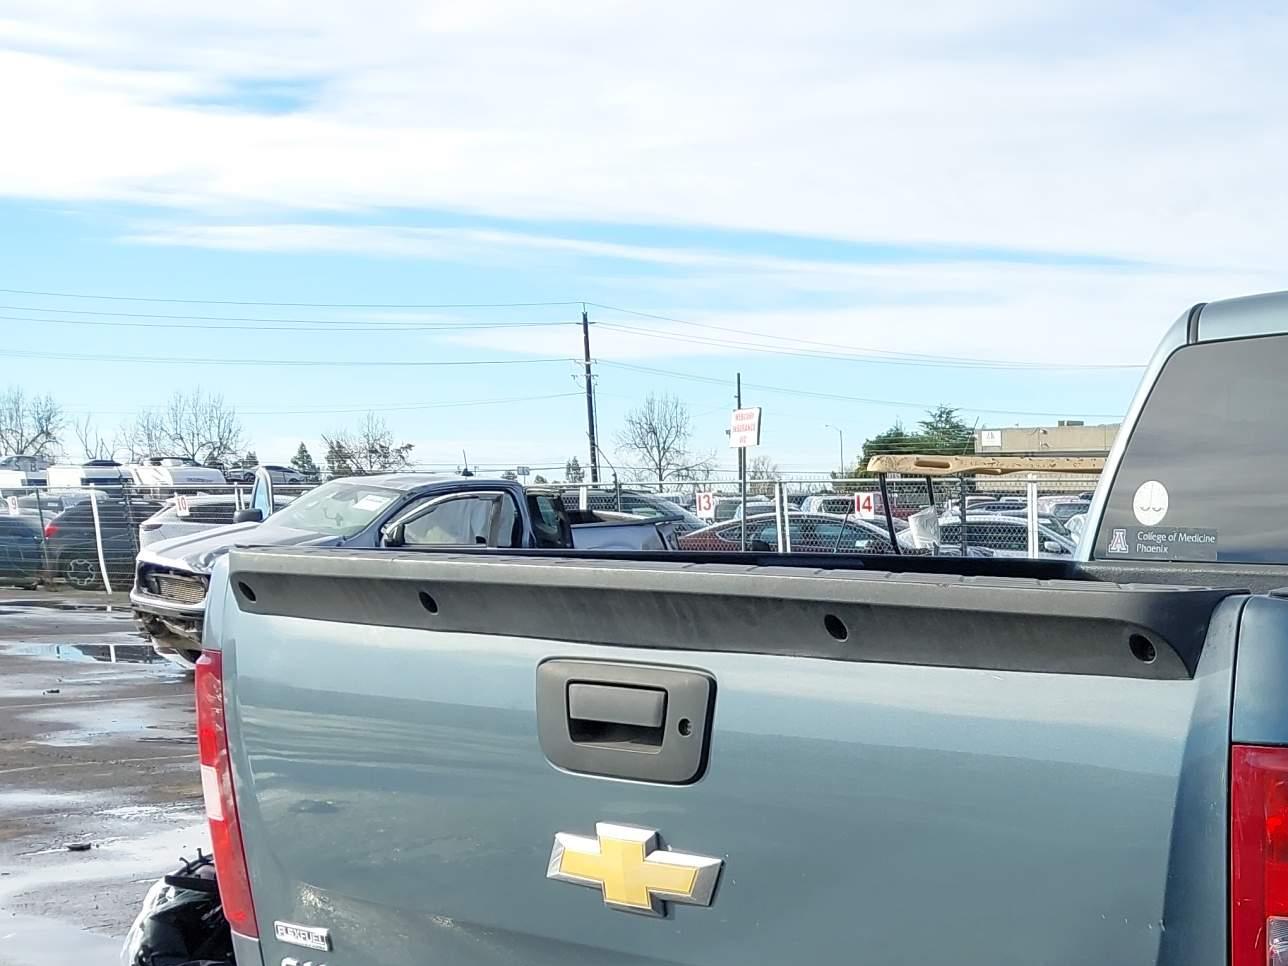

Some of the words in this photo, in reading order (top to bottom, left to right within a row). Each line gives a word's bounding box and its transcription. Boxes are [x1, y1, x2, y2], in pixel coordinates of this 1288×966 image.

[177, 497, 187, 510] 10
[697, 494, 712, 511] 13
[856, 495, 873, 512] 14
[1137, 531, 1166, 543] College
[1168, 531, 1177, 542] of
[1178, 532, 1216, 543] Medicine
[1136, 544, 1169, 553] Phoenix
